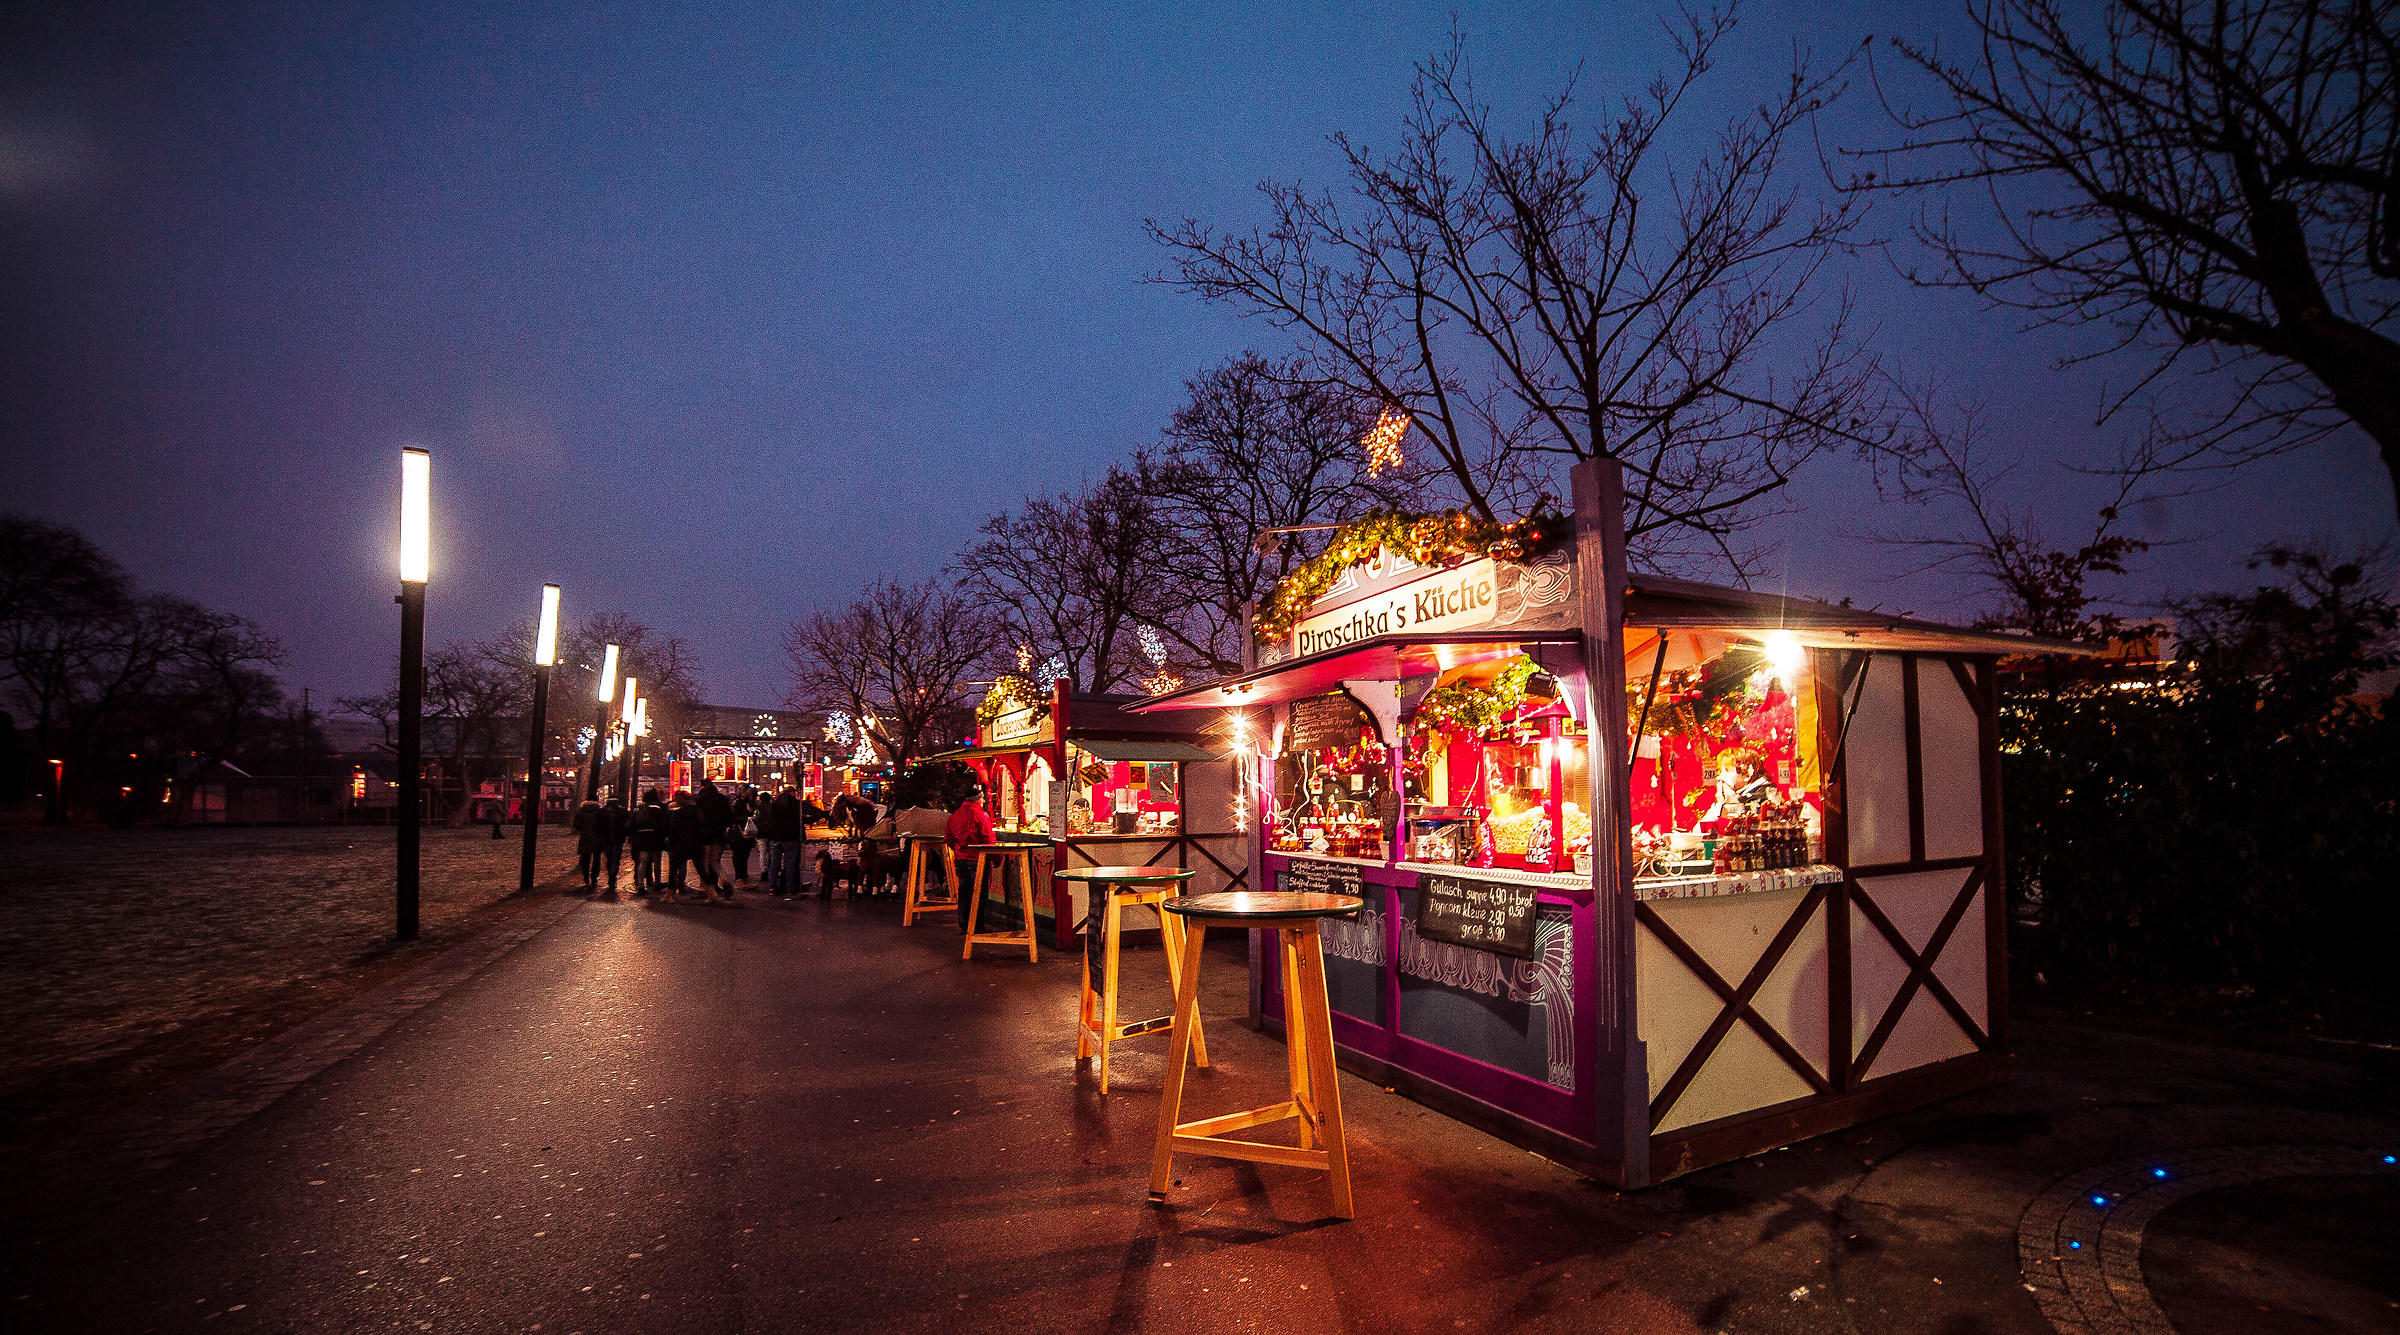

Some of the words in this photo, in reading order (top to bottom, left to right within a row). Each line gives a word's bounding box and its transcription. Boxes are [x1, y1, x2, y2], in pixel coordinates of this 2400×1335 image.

[1298, 601, 1407, 657] Piroschka's
[1414, 577, 1492, 624] Küche
[1430, 879, 1463, 898] Gulasch
[1466, 889, 1488, 905] suppe
[1489, 887, 1507, 906] 4,90
[1429, 898, 1461, 917] Popcorn
[1486, 926, 1506, 942] 3,90
